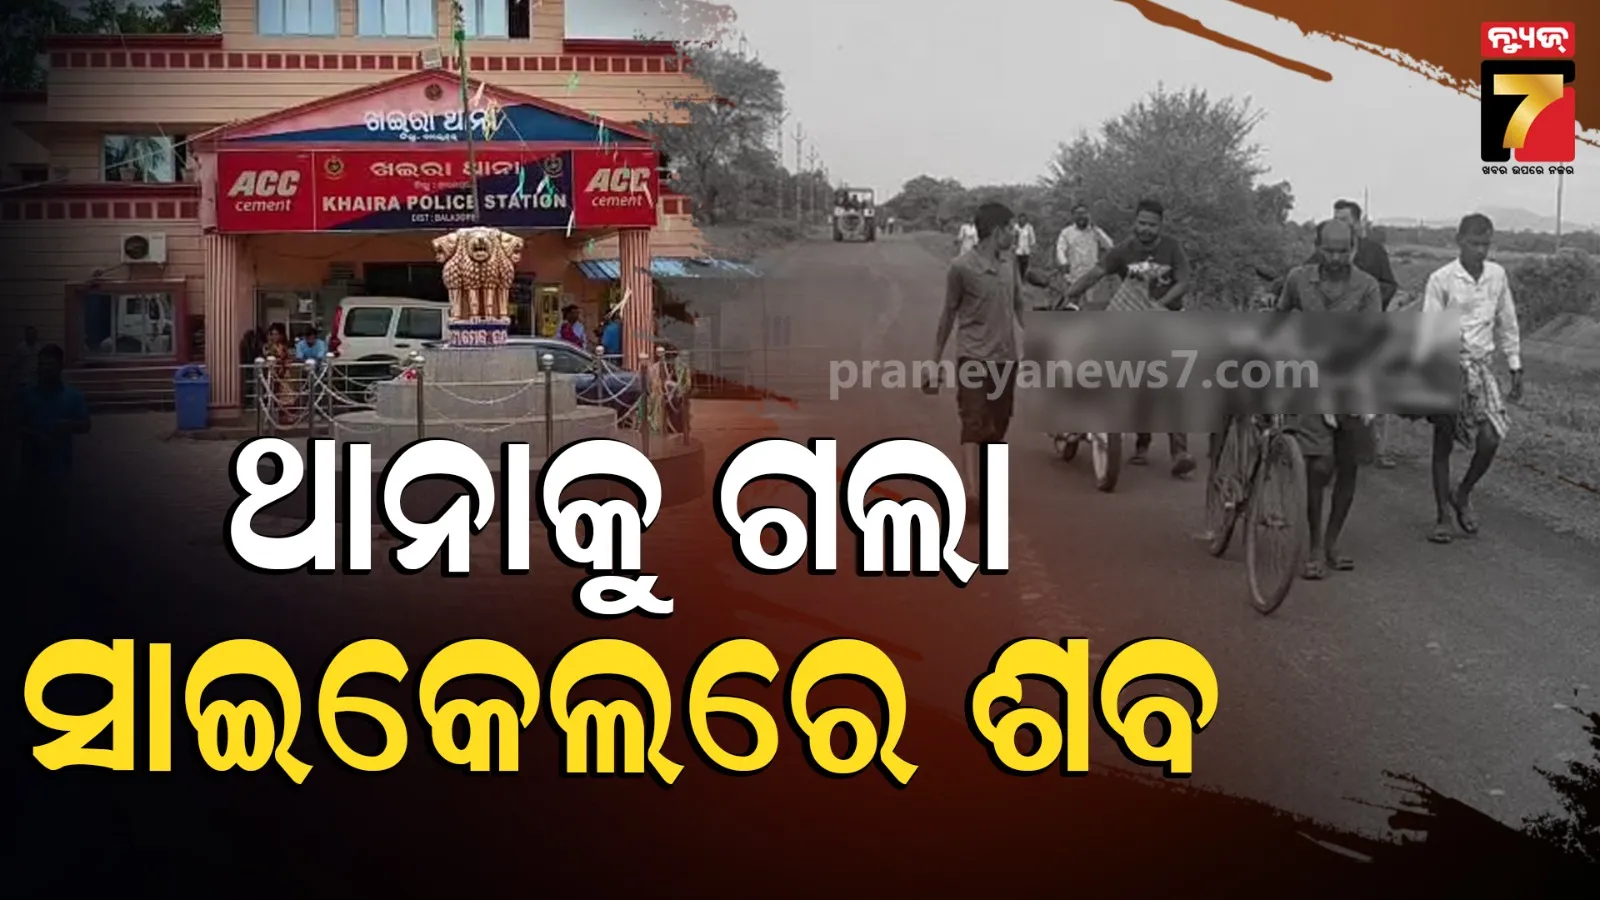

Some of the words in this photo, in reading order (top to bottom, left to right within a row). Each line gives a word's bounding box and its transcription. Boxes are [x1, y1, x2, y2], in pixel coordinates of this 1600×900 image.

[228, 169, 300, 197] ACC
[584, 167, 651, 193] ACC
[235, 199, 291, 212] cement
[322, 196, 400, 212] KHAIRA
[407, 195, 475, 211] POLICE
[484, 194, 567, 209] STATION
[592, 195, 642, 207] cement
